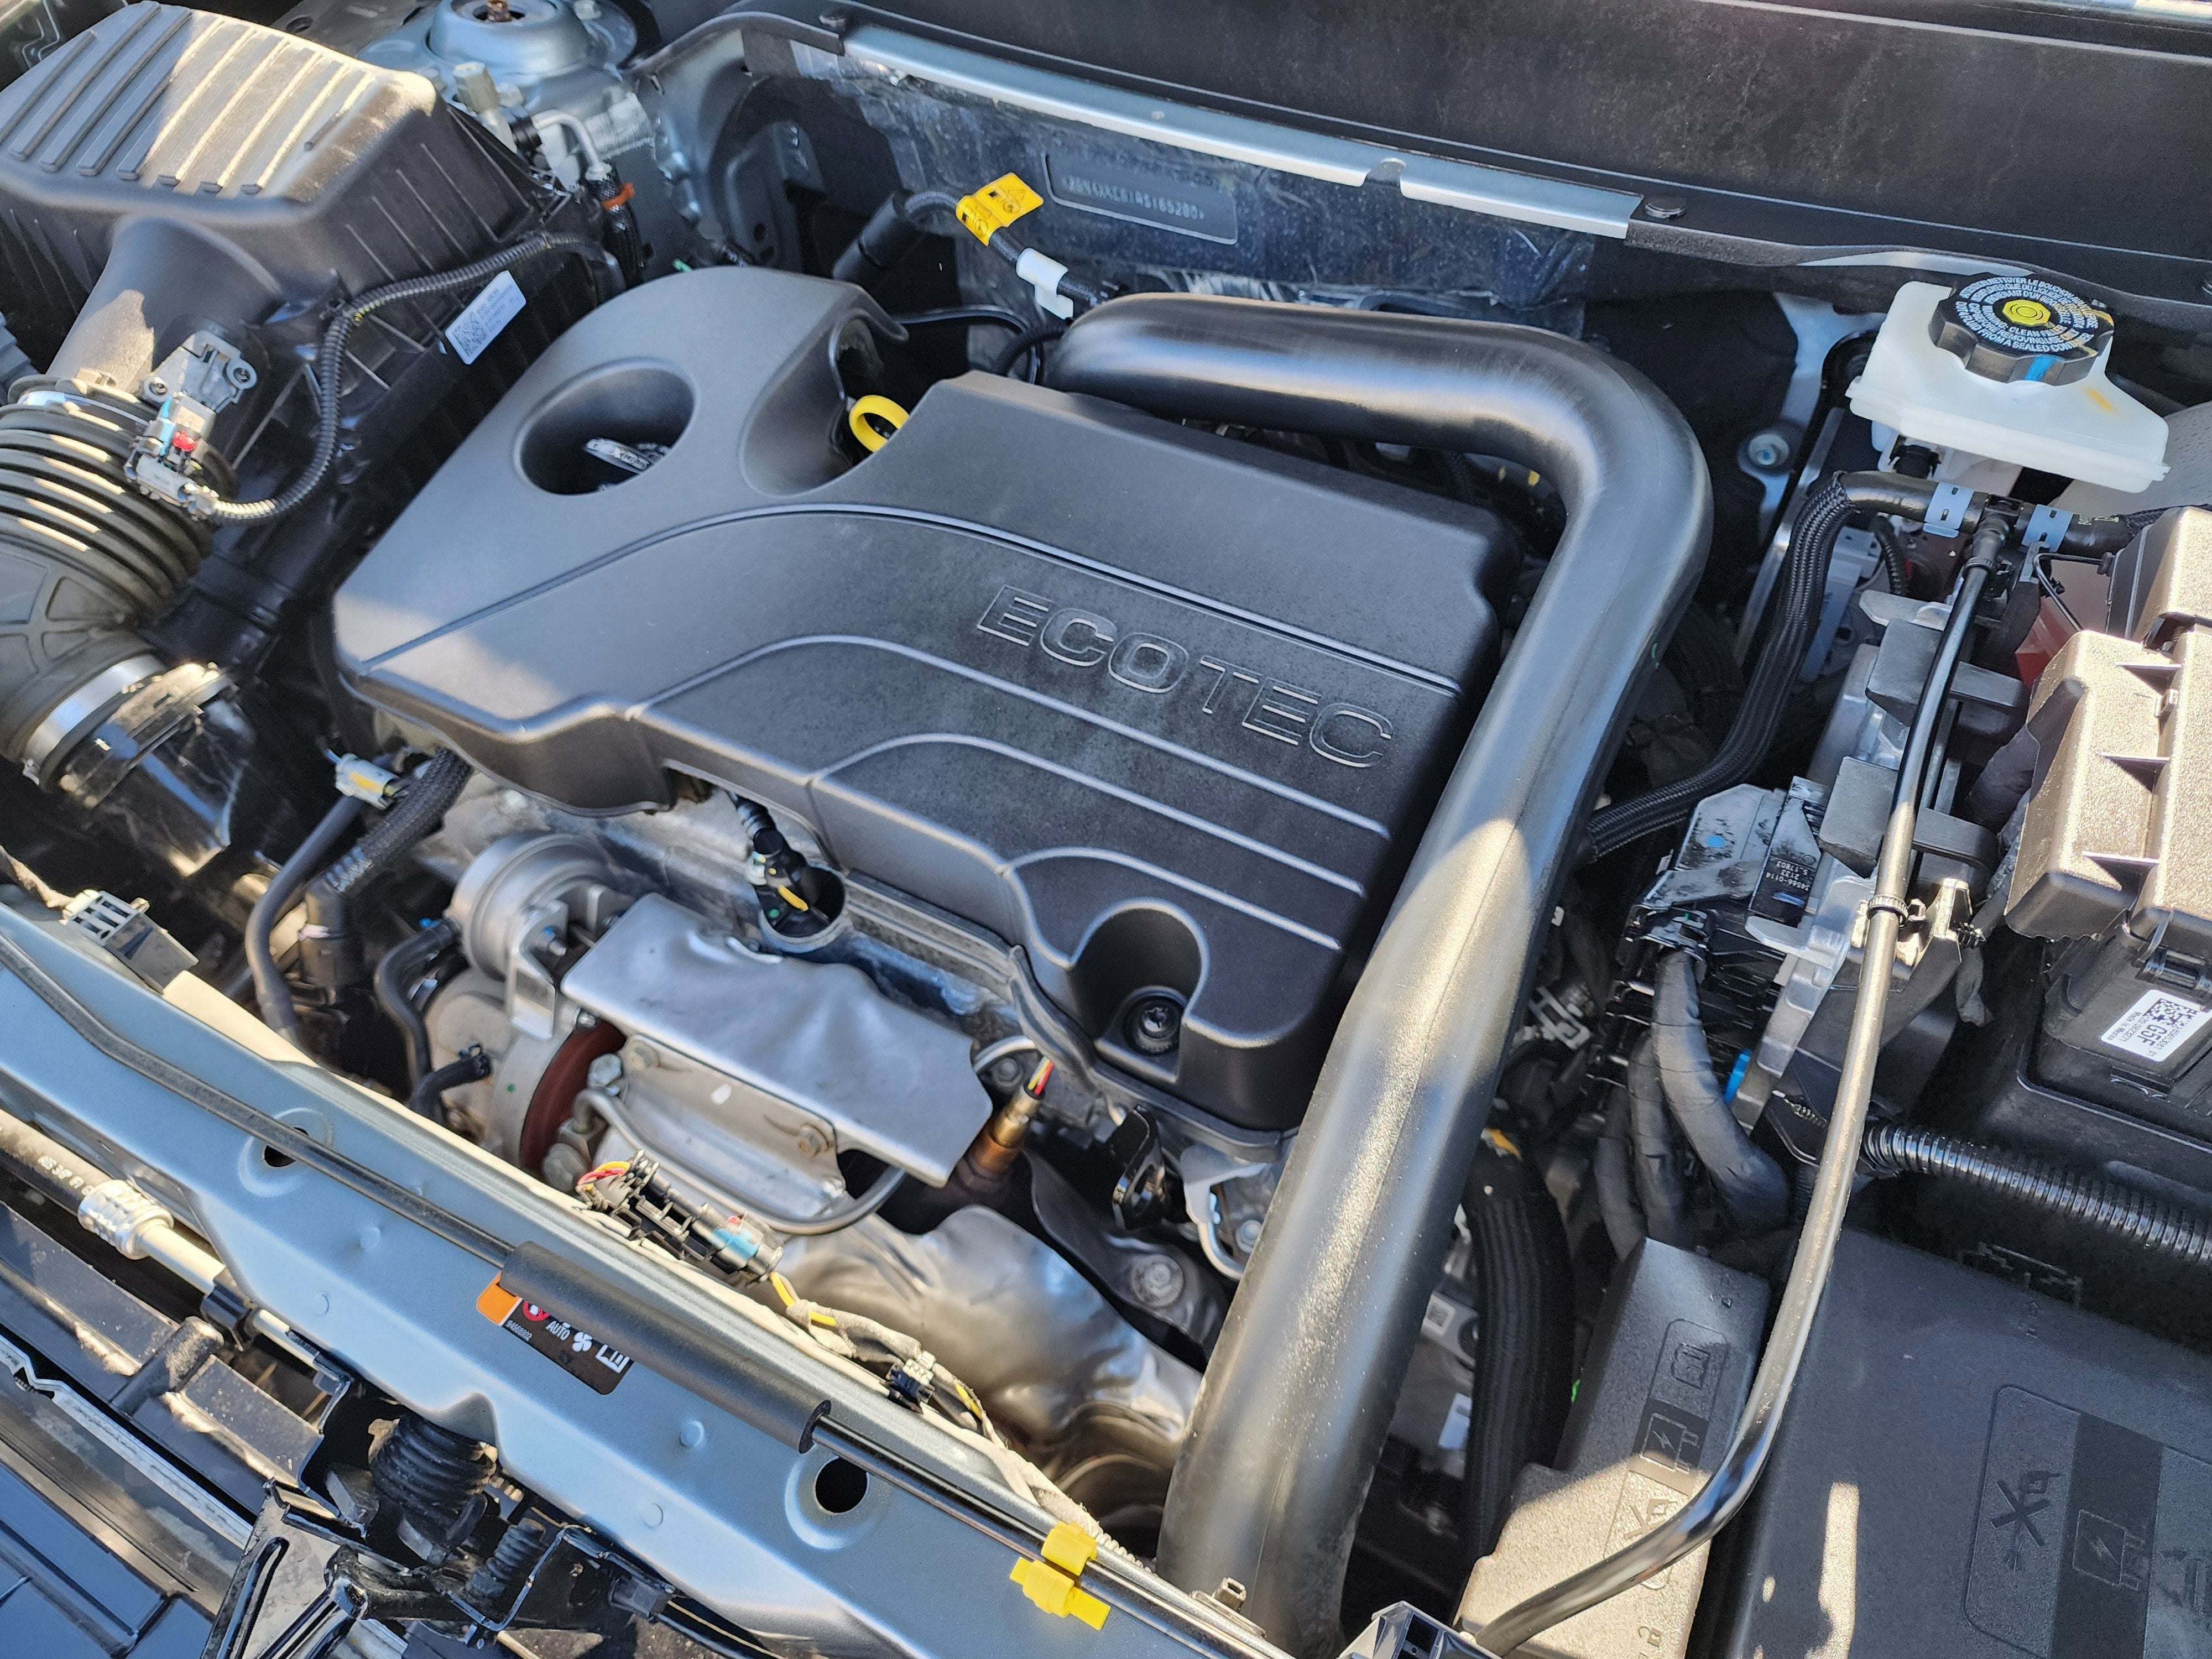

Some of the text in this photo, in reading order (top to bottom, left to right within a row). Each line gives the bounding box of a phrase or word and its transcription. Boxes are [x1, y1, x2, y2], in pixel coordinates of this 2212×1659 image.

[1987, 277, 2027, 286] NETTOYER
[2038, 281, 2074, 300] BOUCHON
[2033, 286, 2062, 300] LIQUIDE
[1968, 302, 1981, 314] CAP
[1972, 314, 2001, 333] BEFORE
[1960, 315, 1982, 331] FLUID
[1977, 328, 2005, 344] FROM
[2012, 341, 2050, 352] SEALED
[2008, 327, 2040, 337] CLEAN
[2040, 325, 2068, 337] FILLER
[2045, 335, 2064, 344] USE
[977, 586, 1394, 768] ECOTEC
[1781, 869, 1799, 880] 2133
[2126, 1011, 2142, 1022] Made
[2107, 1027, 2125, 1040] Mexico
[2137, 1024, 2167, 1046] G5F
[545, 1321, 570, 1340] AUTO
